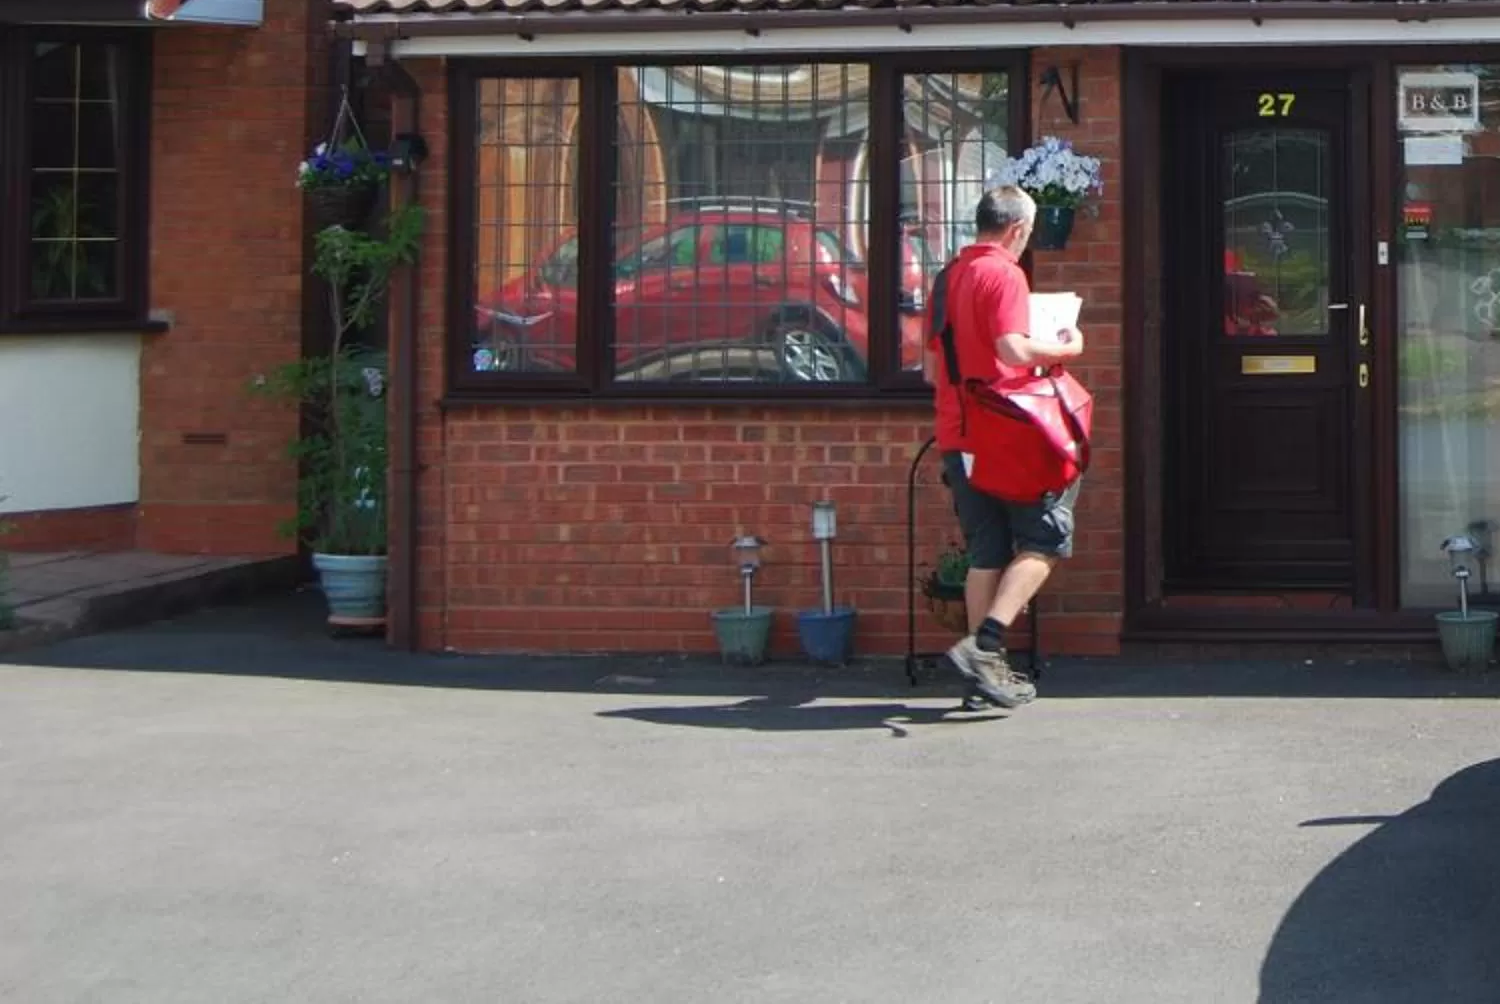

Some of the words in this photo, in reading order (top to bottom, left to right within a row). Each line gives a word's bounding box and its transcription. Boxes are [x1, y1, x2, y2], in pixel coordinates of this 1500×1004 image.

[1258, 93, 1296, 117] 27
[1412, 94, 1425, 110] B
[1430, 94, 1445, 110] &
[1454, 94, 1468, 110] B
